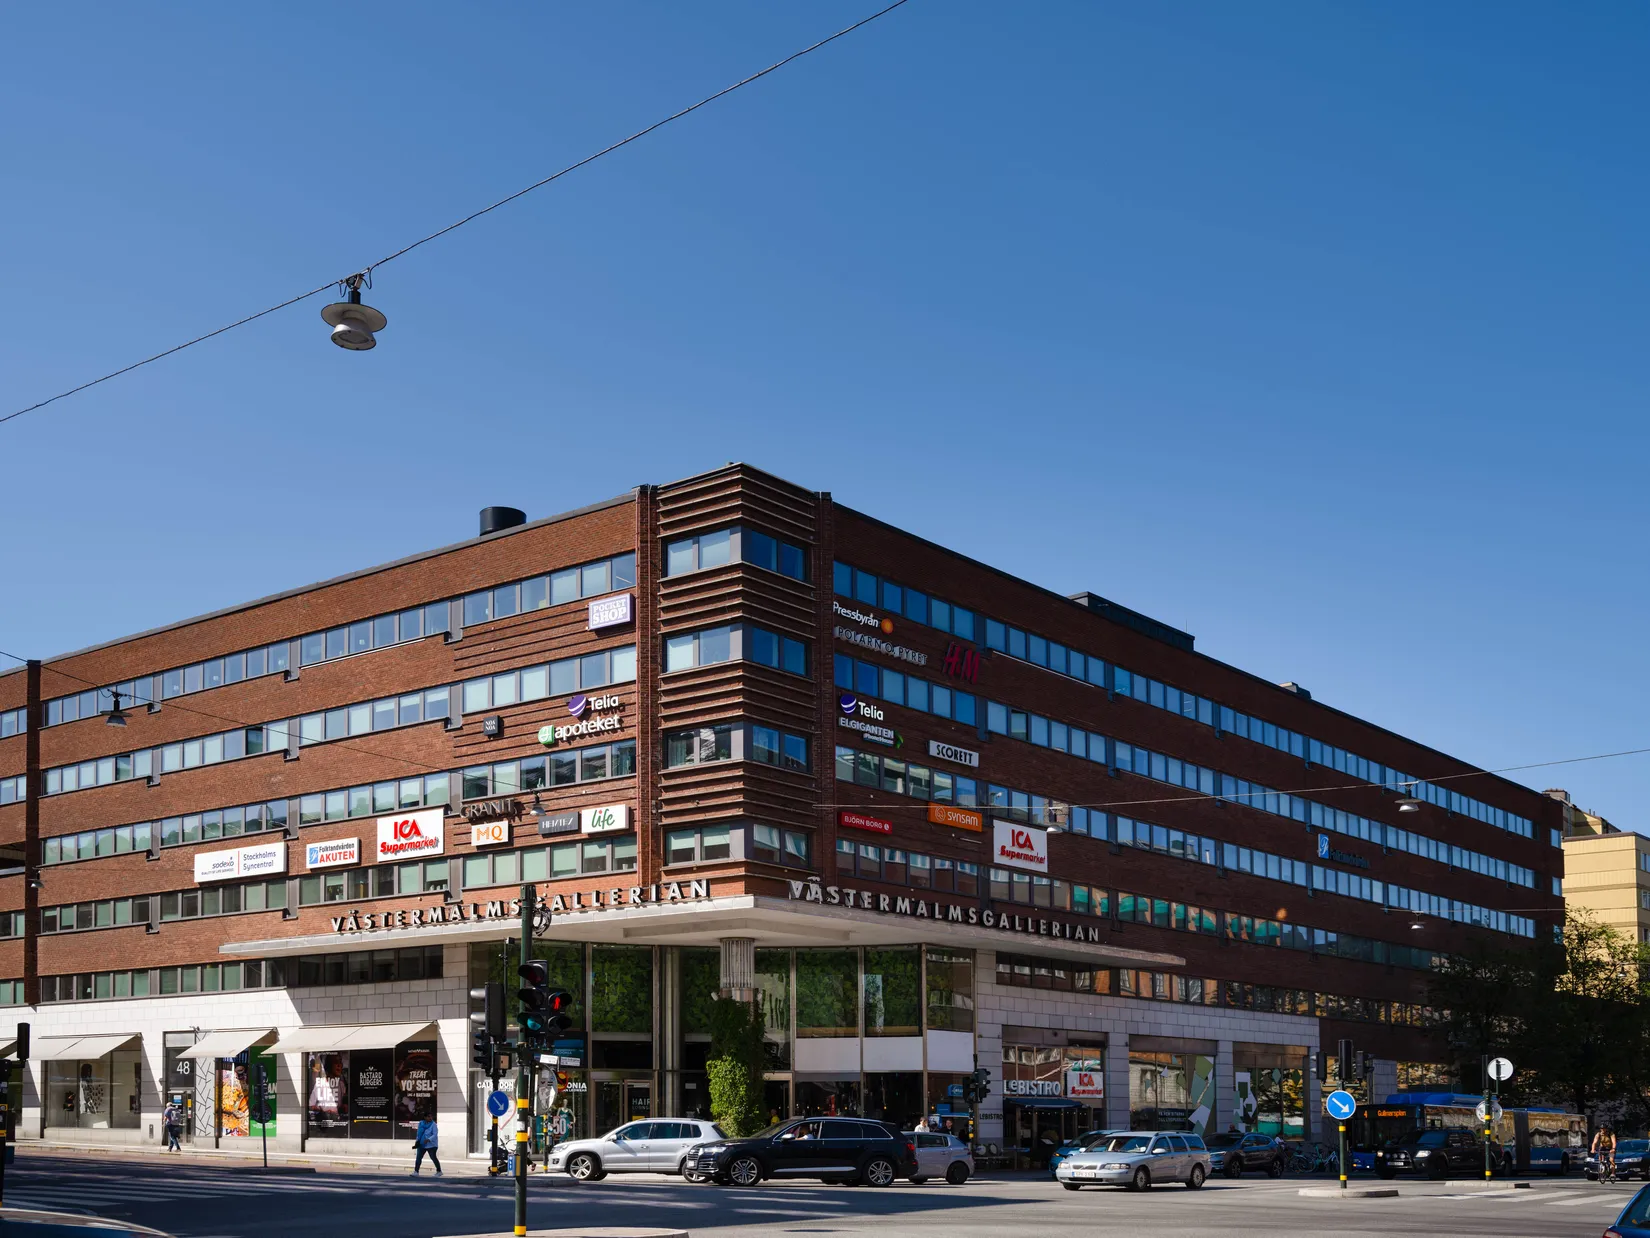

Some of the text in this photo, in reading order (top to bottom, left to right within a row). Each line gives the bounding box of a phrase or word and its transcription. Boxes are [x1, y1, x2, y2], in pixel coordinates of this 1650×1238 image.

[593, 599, 626, 613] POCKET
[833, 601, 879, 628] Pressbyrån
[592, 607, 627, 625] SHOP
[834, 625, 882, 650] POLARN
[896, 646, 928, 666] PYRET
[942, 641, 981, 685] H&M
[588, 694, 619, 711] Telia
[858, 701, 884, 721] Telia
[554, 714, 620, 741] apoteket
[839, 717, 894, 739] ELGIGANTEN
[936, 744, 973, 764] SCORETT
[459, 798, 517, 818] GRANIT
[591, 808, 615, 830] life
[844, 815, 883, 829] BJÖRN BORG
[947, 811, 979, 827] SYNSAM
[393, 819, 422, 840] ICA
[476, 825, 504, 842] MQ
[319, 842, 355, 853] Folktandvården
[380, 836, 437, 855] Supermarket
[1011, 829, 1034, 851] ICA
[243, 851, 276, 861] Stockholms
[319, 850, 355, 863] AKUTEN
[1000, 845, 1046, 865] Supermarket
[212, 860, 235, 869] sodexo
[243, 860, 274, 871] Syncentral
[789, 876, 1100, 942] VÄSTERMALMSGALLERIAN
[176, 1061, 190, 1075] 48
[359, 1071, 383, 1079] BASTARD
[409, 1070, 428, 1079] TREAT
[316, 1077, 340, 1087] ENJOY
[359, 1078, 383, 1086] BURGERS
[416, 1080, 437, 1091] SELF
[1079, 1073, 1094, 1087] ICA
[317, 1087, 339, 1102] LIFE
[1363, 1109, 1407, 1120] 4 Gullmarsplan
[552, 1115, 567, 1135] 50
